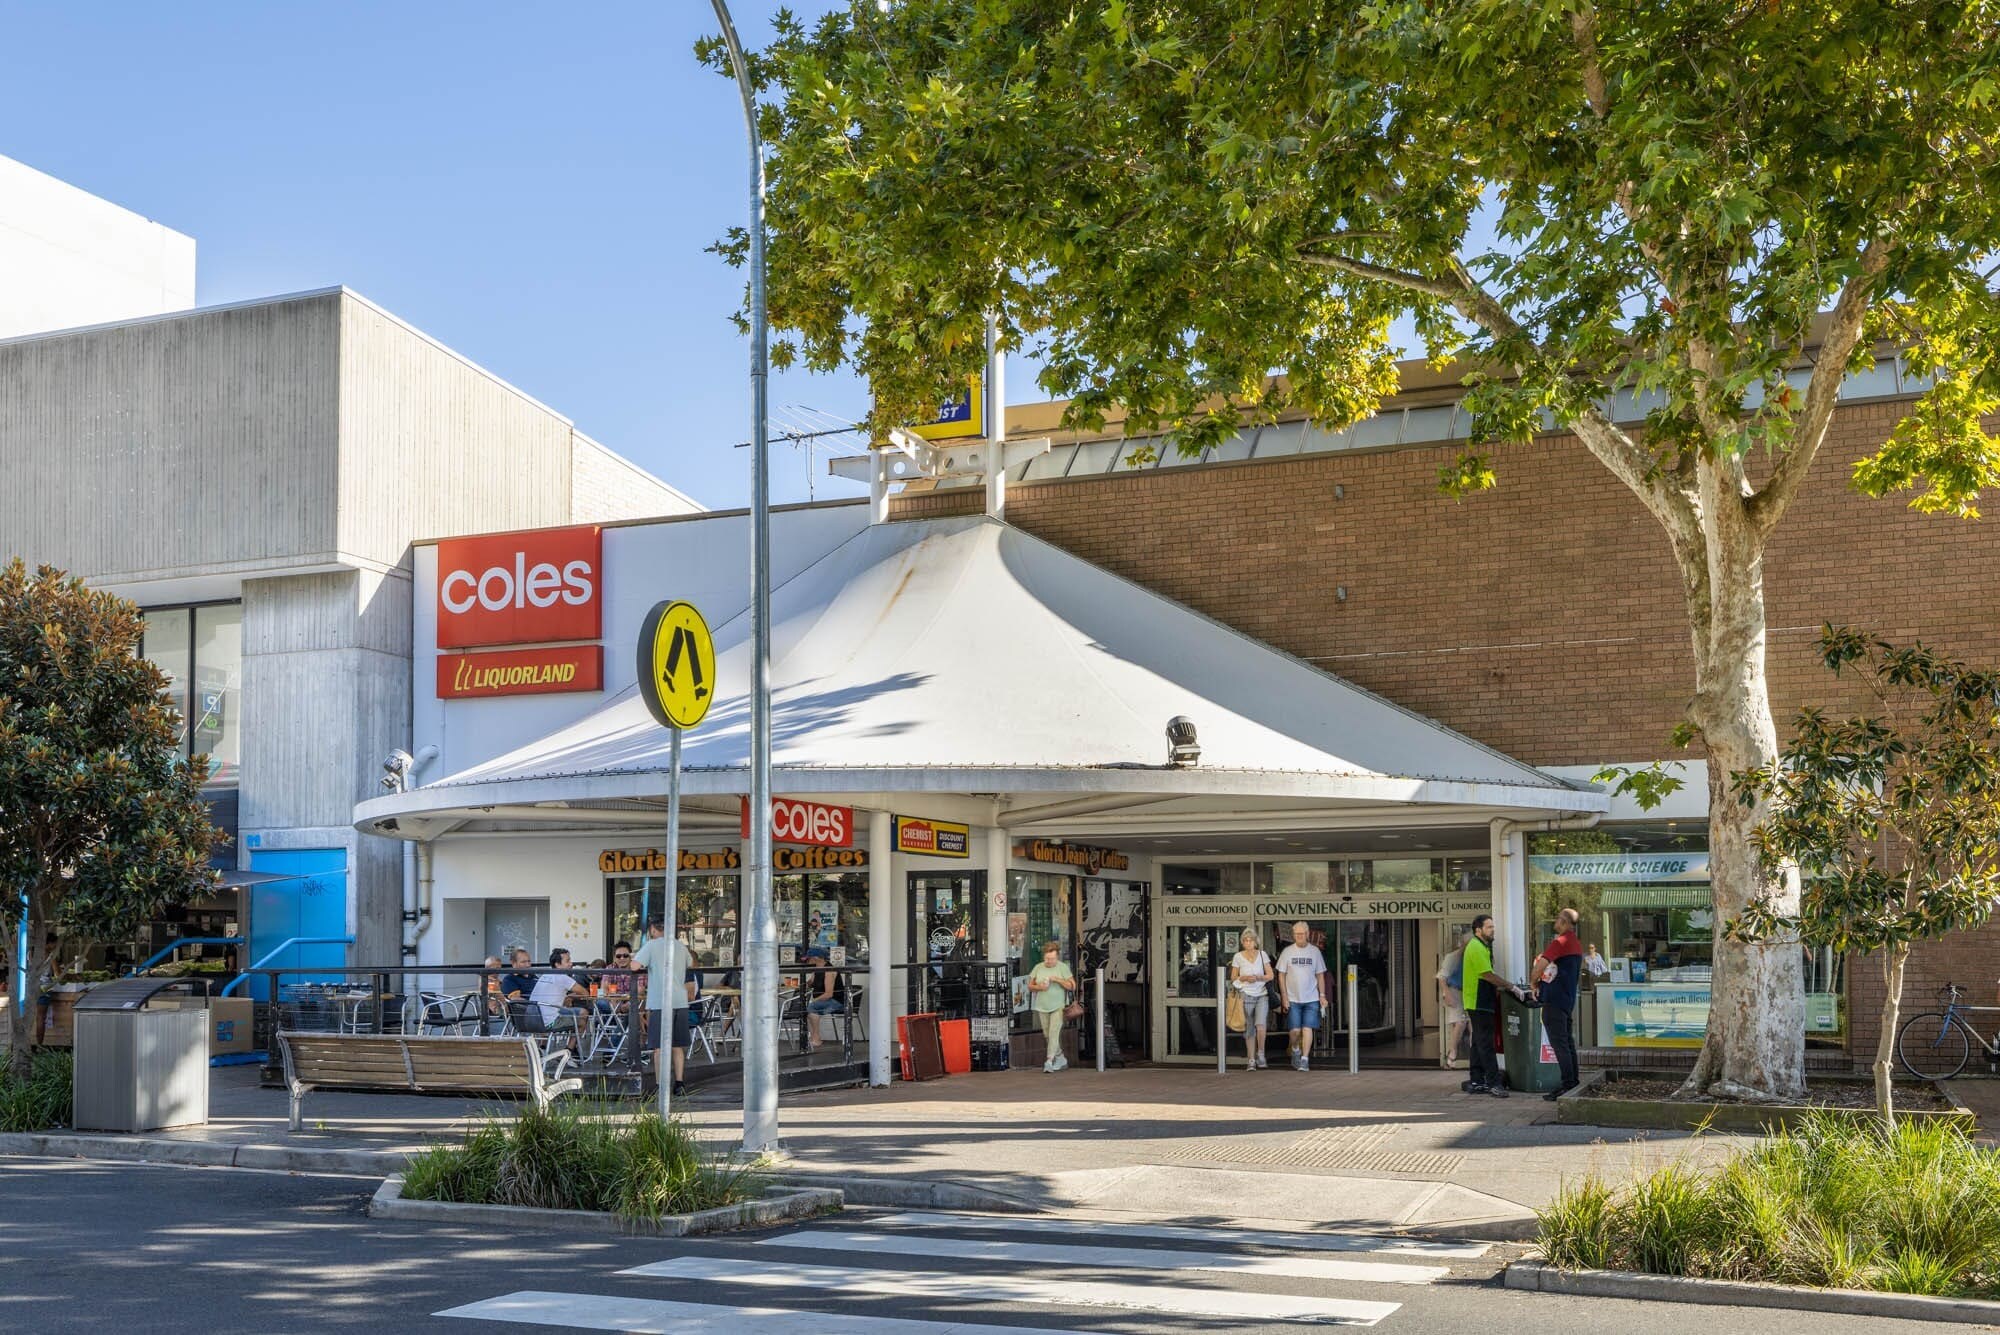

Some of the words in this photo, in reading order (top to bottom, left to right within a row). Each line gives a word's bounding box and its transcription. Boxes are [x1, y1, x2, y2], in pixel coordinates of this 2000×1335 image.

[441, 551, 593, 614] coles
[473, 663, 576, 689] LIQUORLAND
[771, 801, 844, 844] coles
[902, 827, 933, 842] CHEMIST
[939, 833, 965, 842] DISCOUNT
[941, 841, 964, 850] CHEMIST
[1033, 839, 1064, 863] Gloria
[599, 850, 667, 872] Gloria
[677, 848, 739, 870] Jean's
[774, 847, 865, 869] Coffees
[1554, 862, 1627, 875] CHRISTIAN
[1629, 860, 1689, 873] SCIENCE
[1166, 906, 1180, 914] AIR
[1184, 905, 1248, 914] CONDITIONED
[1256, 902, 1358, 916] CONVENIENCE
[1368, 901, 1444, 914] SHOPPING
[1451, 902, 1491, 910] UNDERCO
